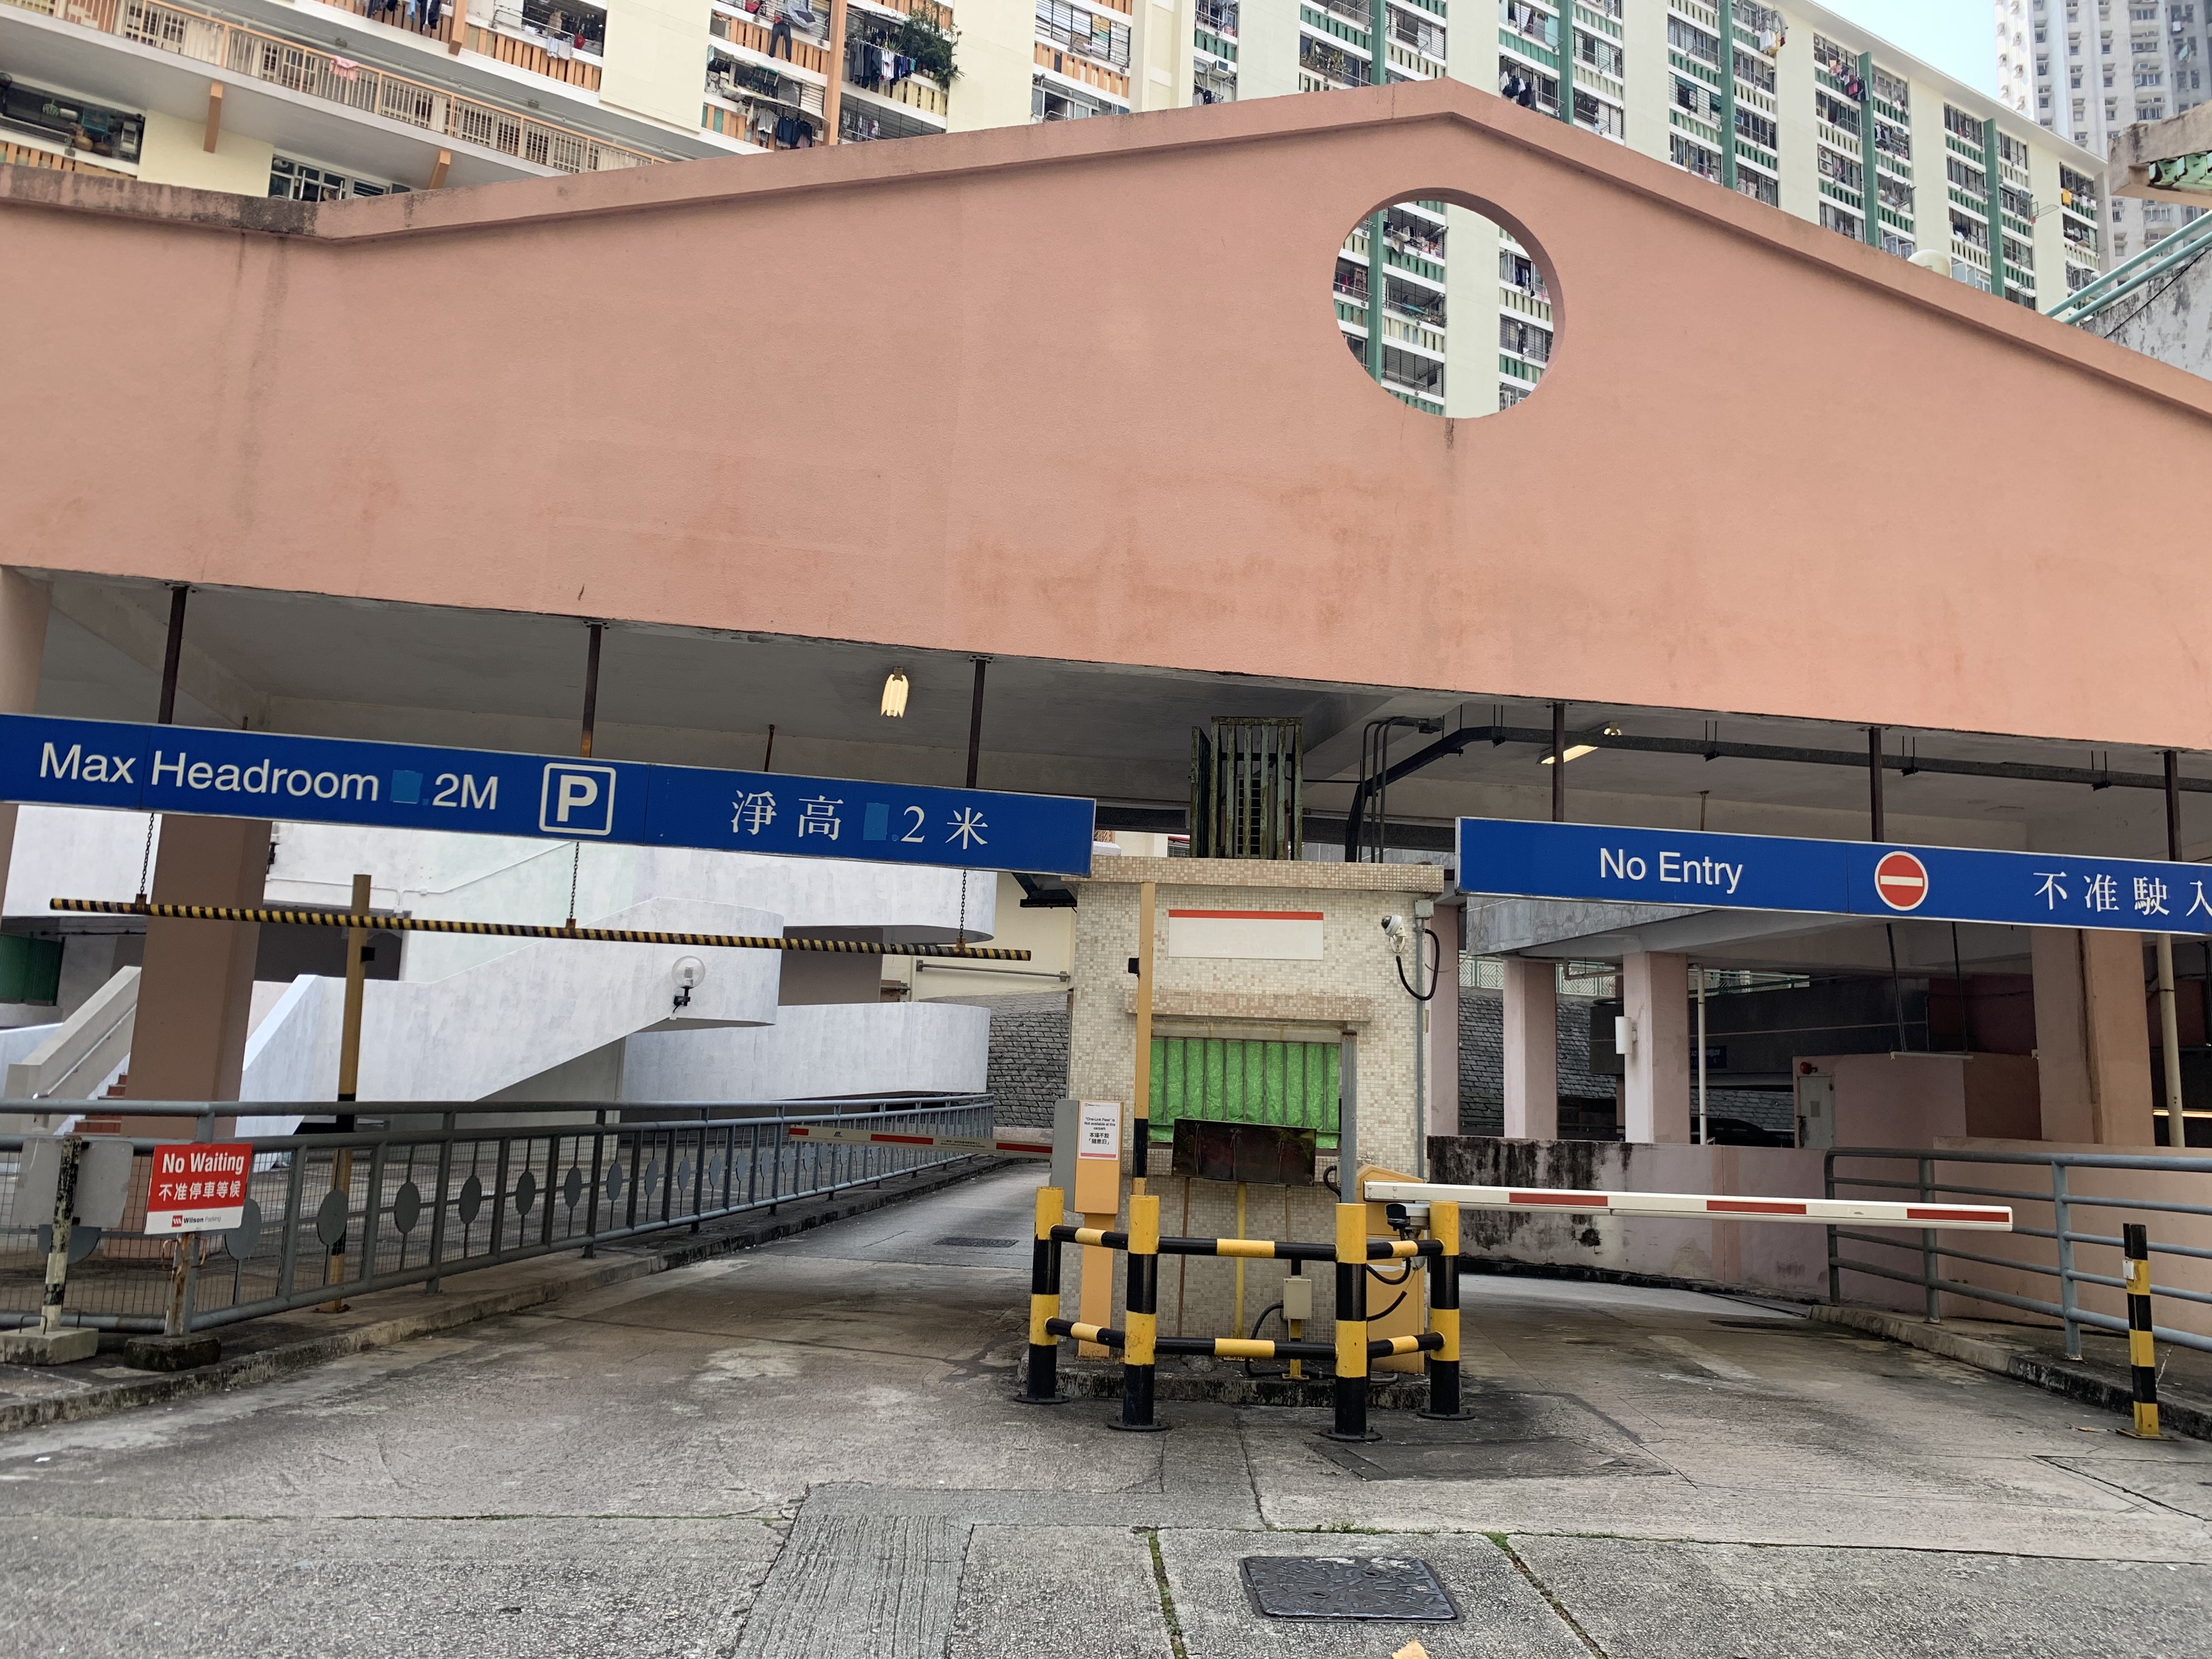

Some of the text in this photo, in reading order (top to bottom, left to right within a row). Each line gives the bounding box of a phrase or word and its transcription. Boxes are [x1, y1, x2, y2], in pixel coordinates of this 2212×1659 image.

[40, 742, 136, 784] Max
[151, 750, 380, 802] Headroom
[556, 774, 598, 822] P
[1600, 848, 1743, 894] No Entry
[2033, 871, 2212, 917] 不准駛入
[162, 1152, 244, 1175] No Waiting
[158, 1180, 241, 1201] 不准停車等候
